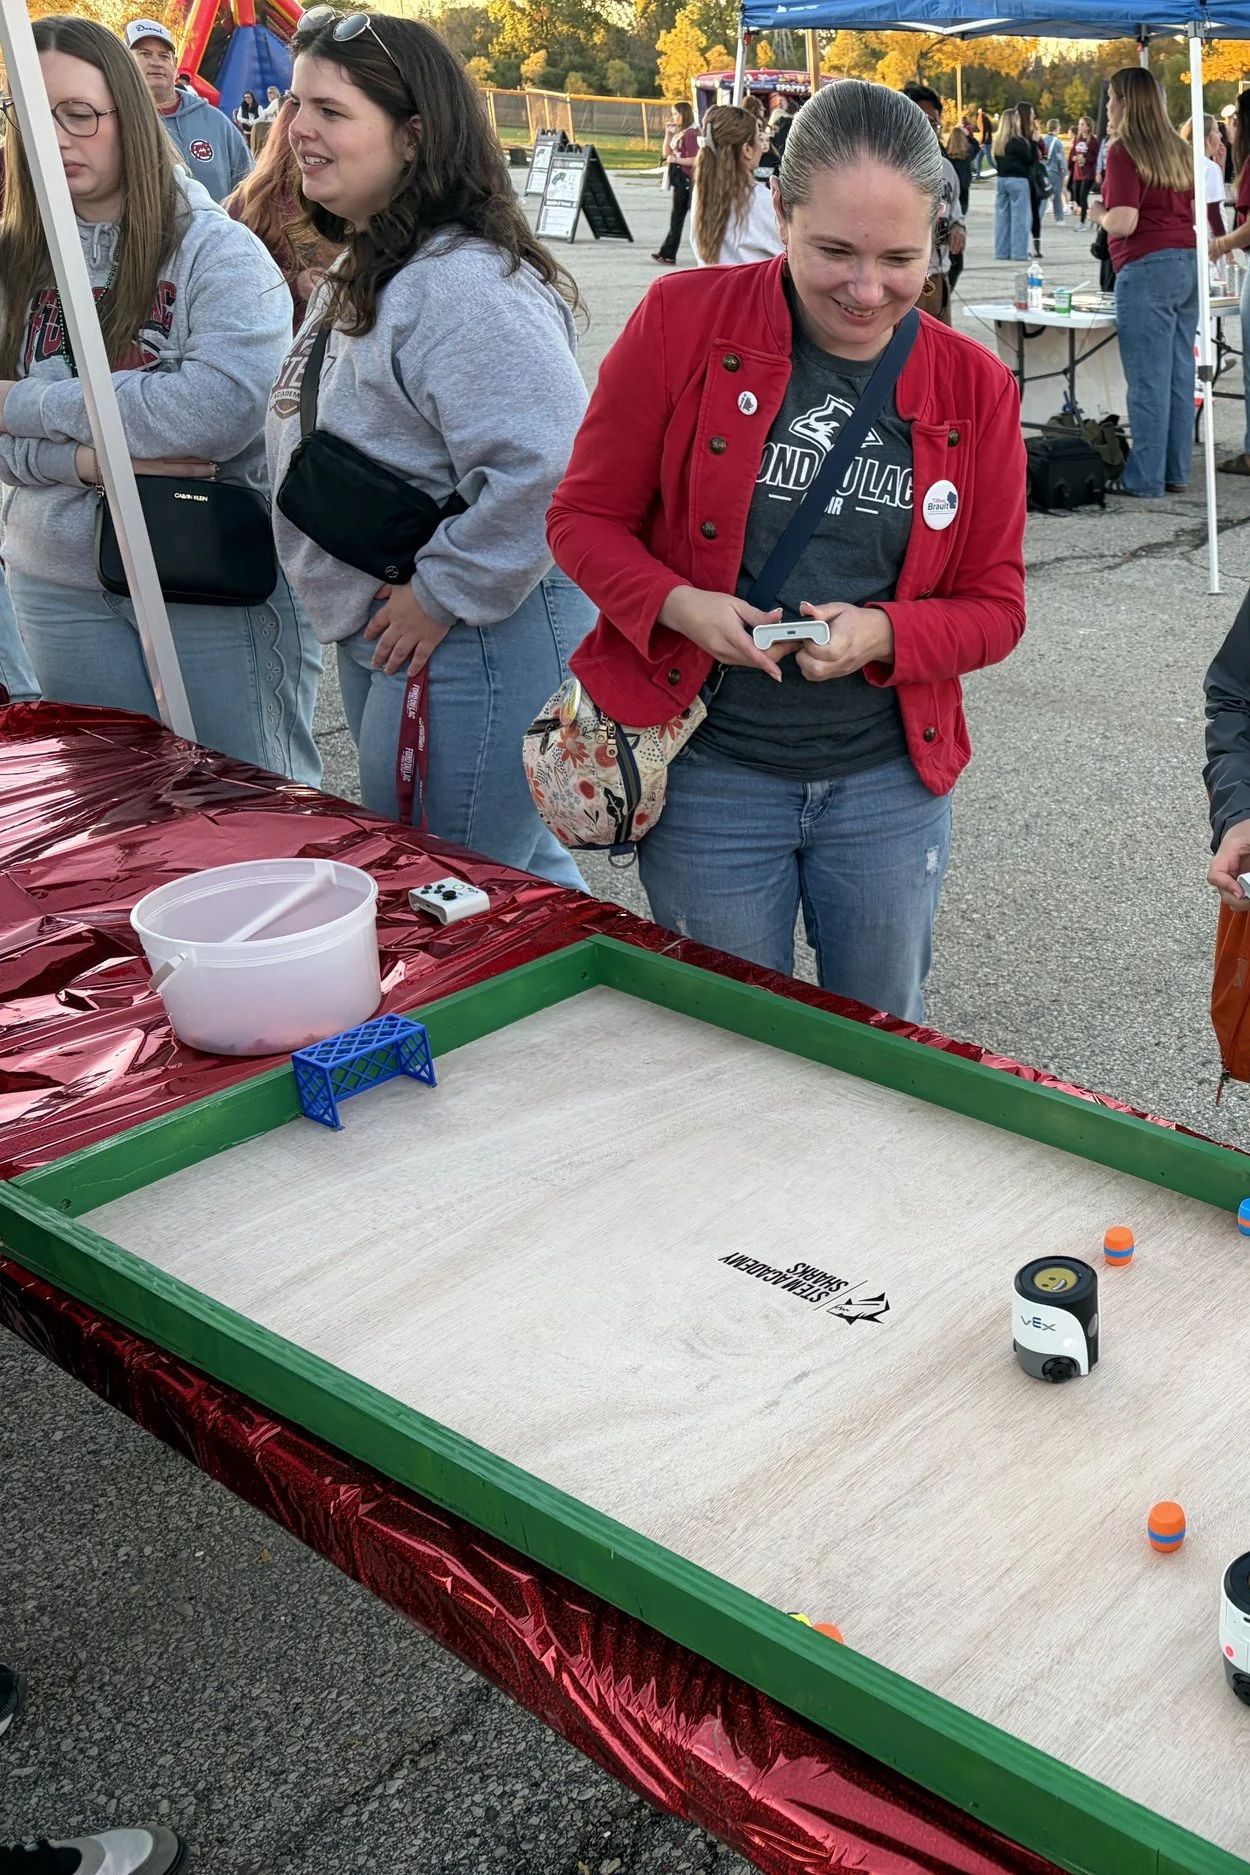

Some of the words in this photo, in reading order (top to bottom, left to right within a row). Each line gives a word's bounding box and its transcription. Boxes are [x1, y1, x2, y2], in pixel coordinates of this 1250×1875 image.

[273, 390, 300, 399] ACADEM
[174, 492, 193, 500] CALVIN
[927, 502, 949, 511] Brault
[717, 1252, 793, 1286] ACADEMY
[785, 1262, 850, 1293] SHARKS
[780, 1278, 831, 1303] STEM
[1020, 1315, 1057, 1332] VEX
